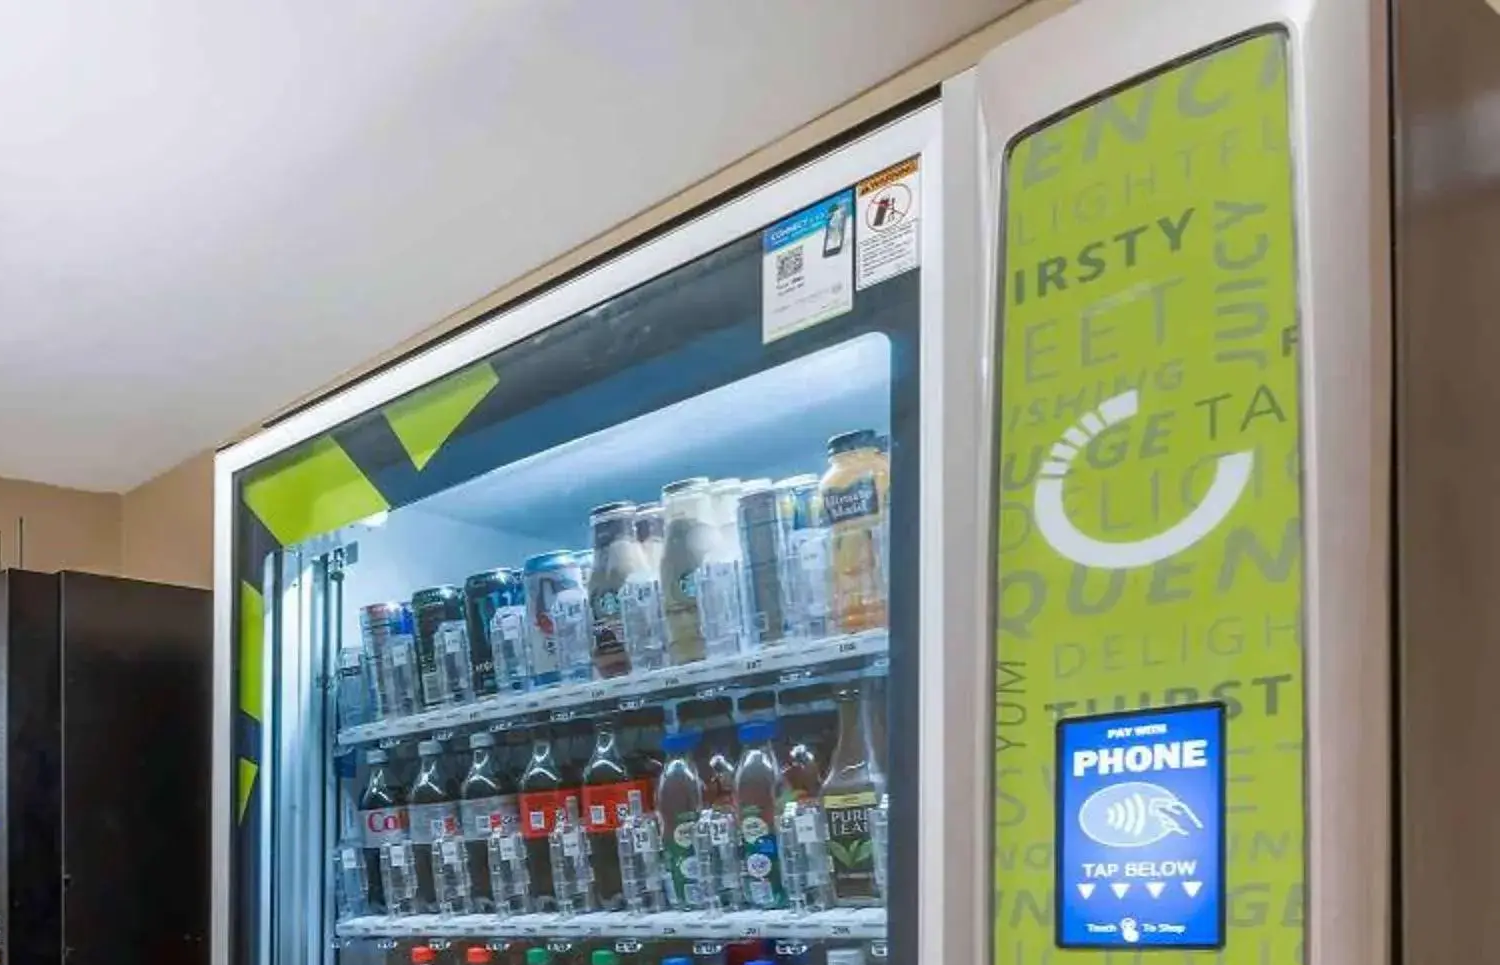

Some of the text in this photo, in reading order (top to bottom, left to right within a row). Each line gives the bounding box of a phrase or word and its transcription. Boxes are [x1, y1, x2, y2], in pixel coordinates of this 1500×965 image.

[1014, 207, 1196, 305] IRSTY
[1107, 728, 1133, 739] PAY
[1072, 739, 1208, 777] PHONE
[1081, 860, 1198, 878] TAP BELOW
